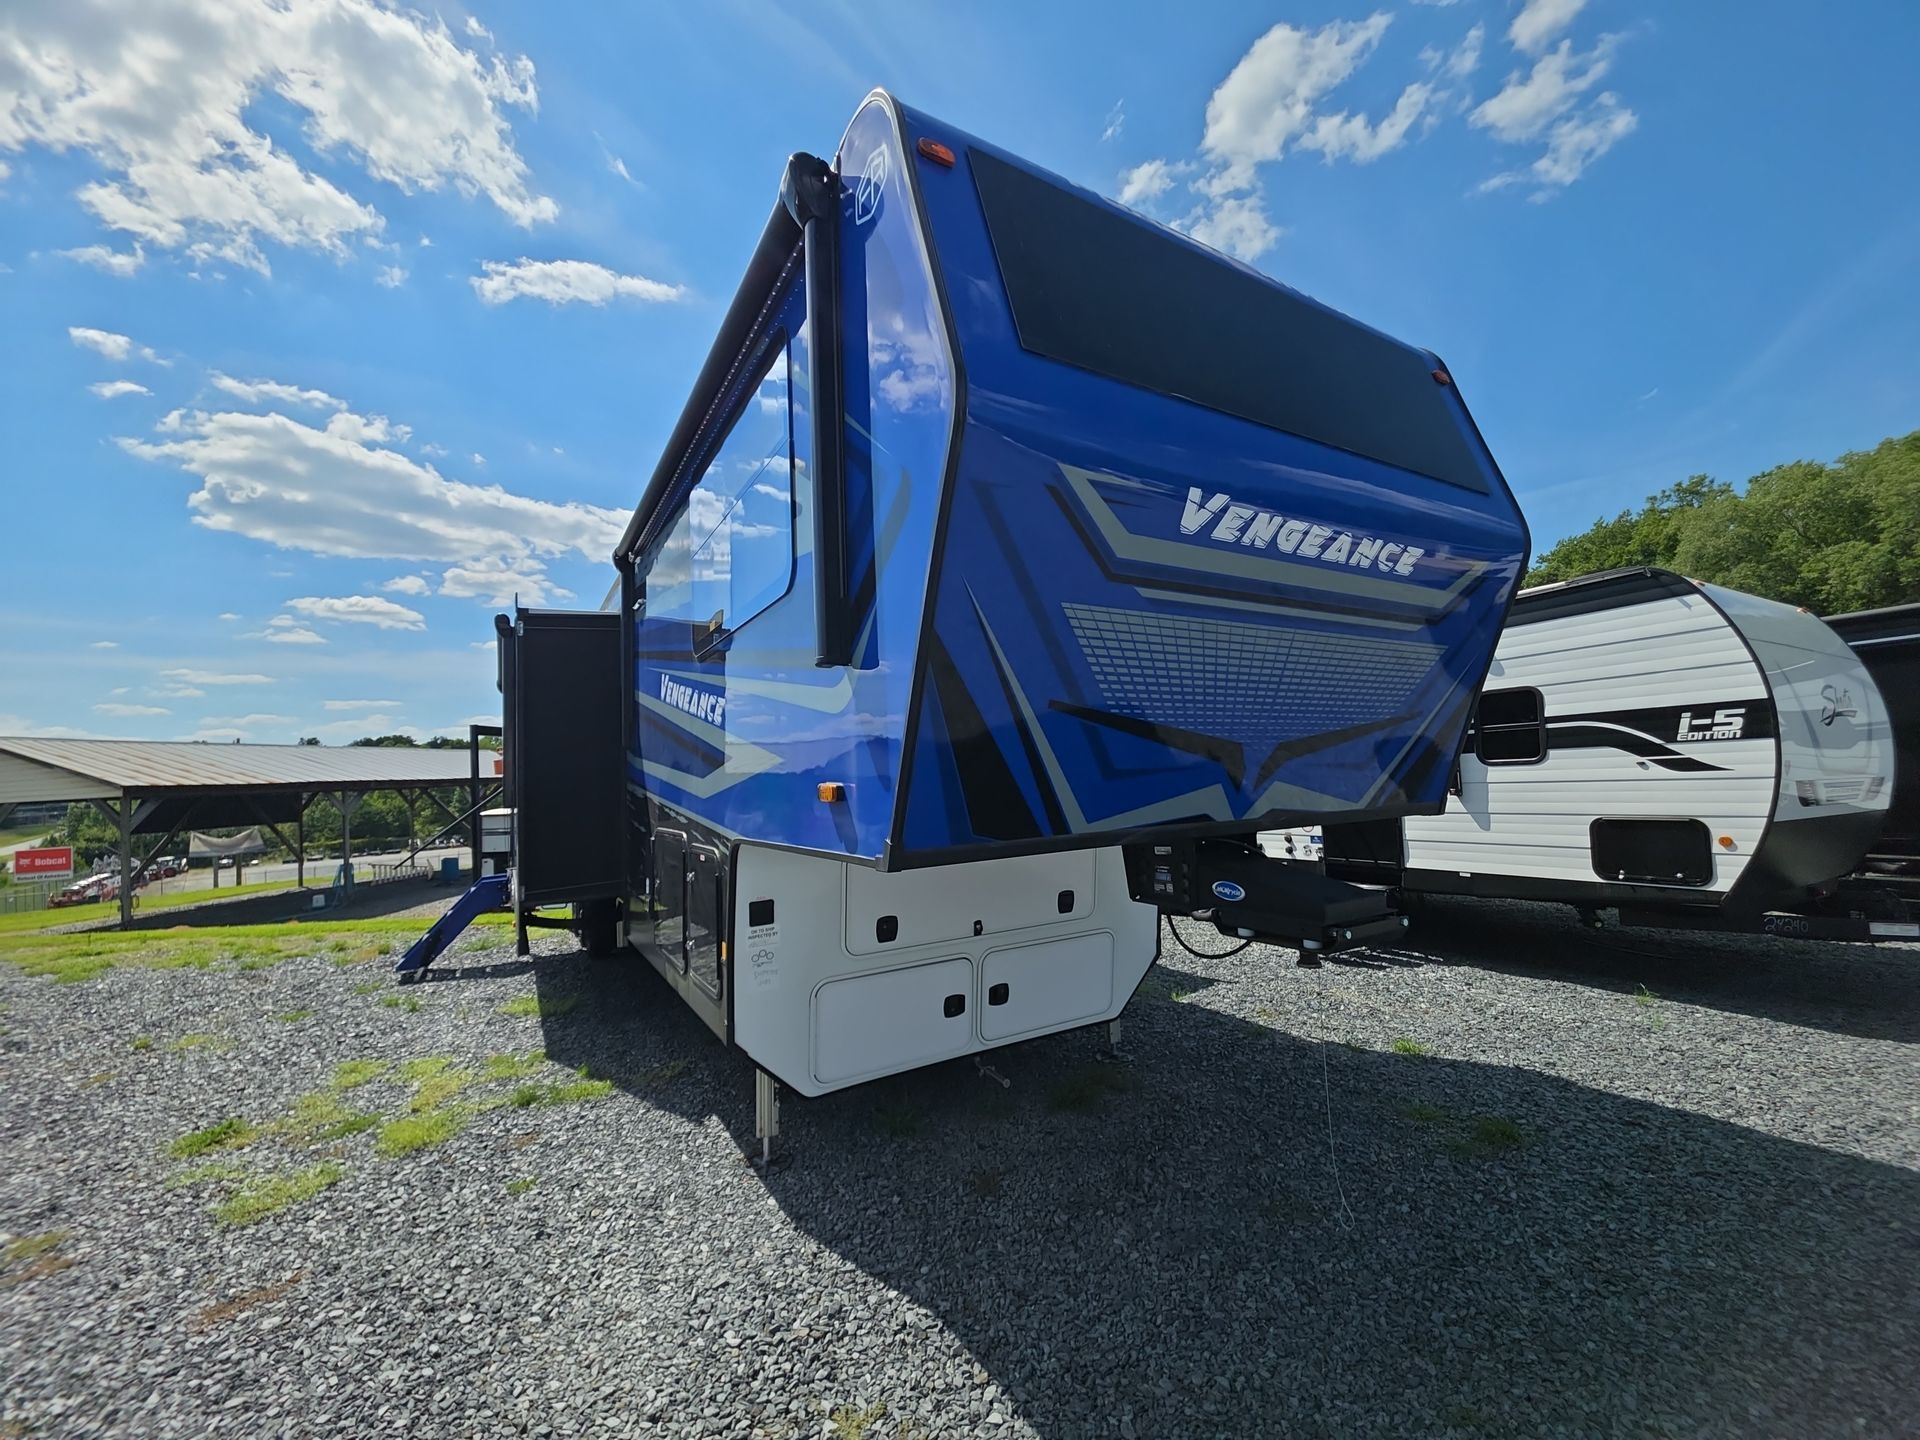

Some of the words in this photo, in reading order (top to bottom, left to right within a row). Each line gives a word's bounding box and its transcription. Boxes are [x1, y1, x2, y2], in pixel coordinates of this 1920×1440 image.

[1180, 486, 1425, 577] VENGEANCE
[660, 673, 726, 726] VENGEANCE
[1676, 730, 1742, 742] EDITION
[34, 856, 67, 866] Bobcat
[1764, 916, 1809, 933] 24240
[747, 932, 772, 940] INSPECTED
